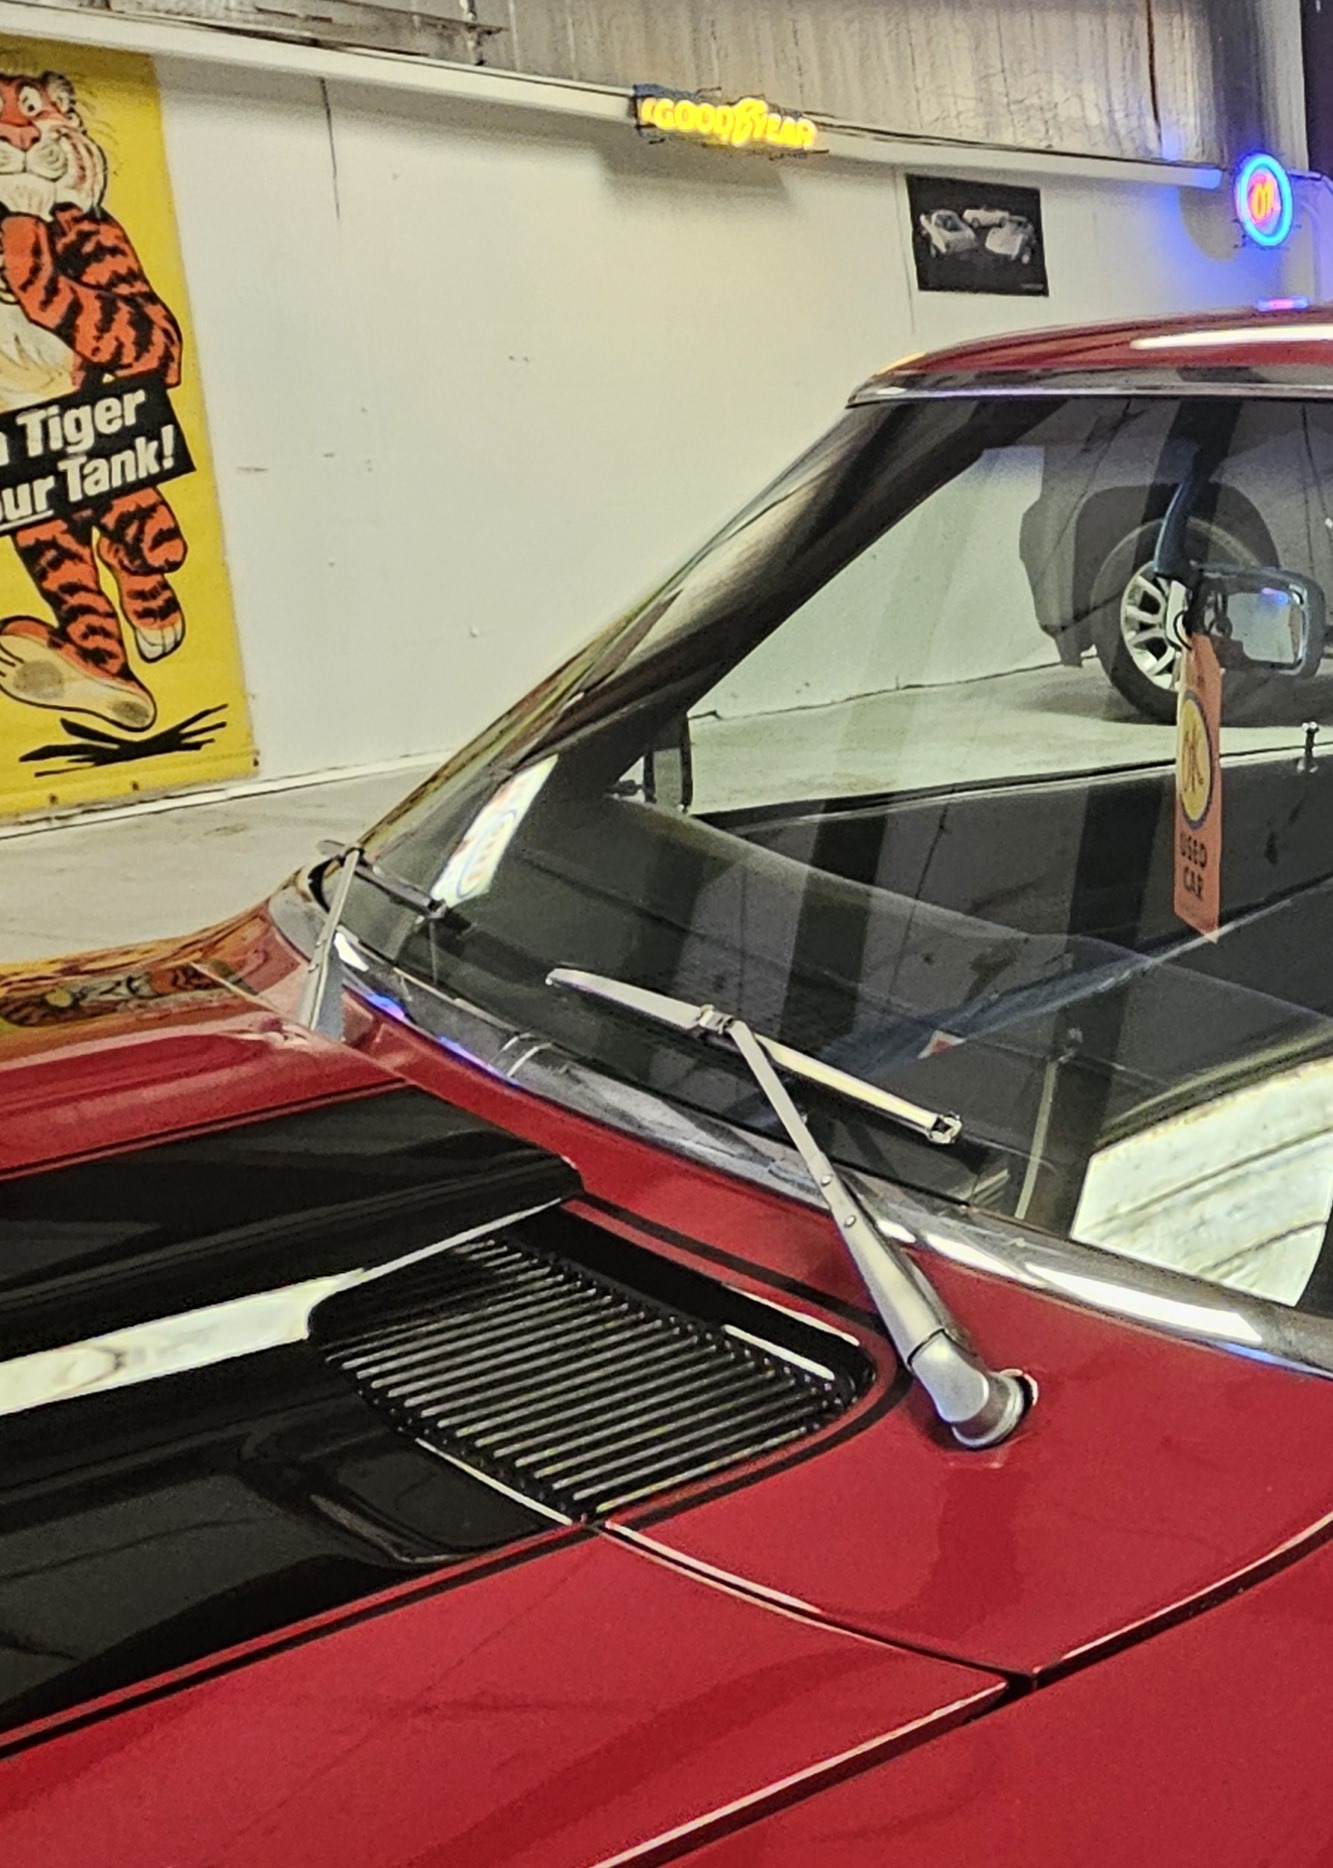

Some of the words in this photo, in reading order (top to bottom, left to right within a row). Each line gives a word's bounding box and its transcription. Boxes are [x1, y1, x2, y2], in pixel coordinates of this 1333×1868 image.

[650, 98, 818, 149] GOODYEAR
[15, 389, 146, 458] Tiger
[0, 475, 55, 522] ur
[57, 424, 175, 503] Tank!
[1179, 833, 1208, 869] USED
[1182, 865, 1204, 902] CAR
